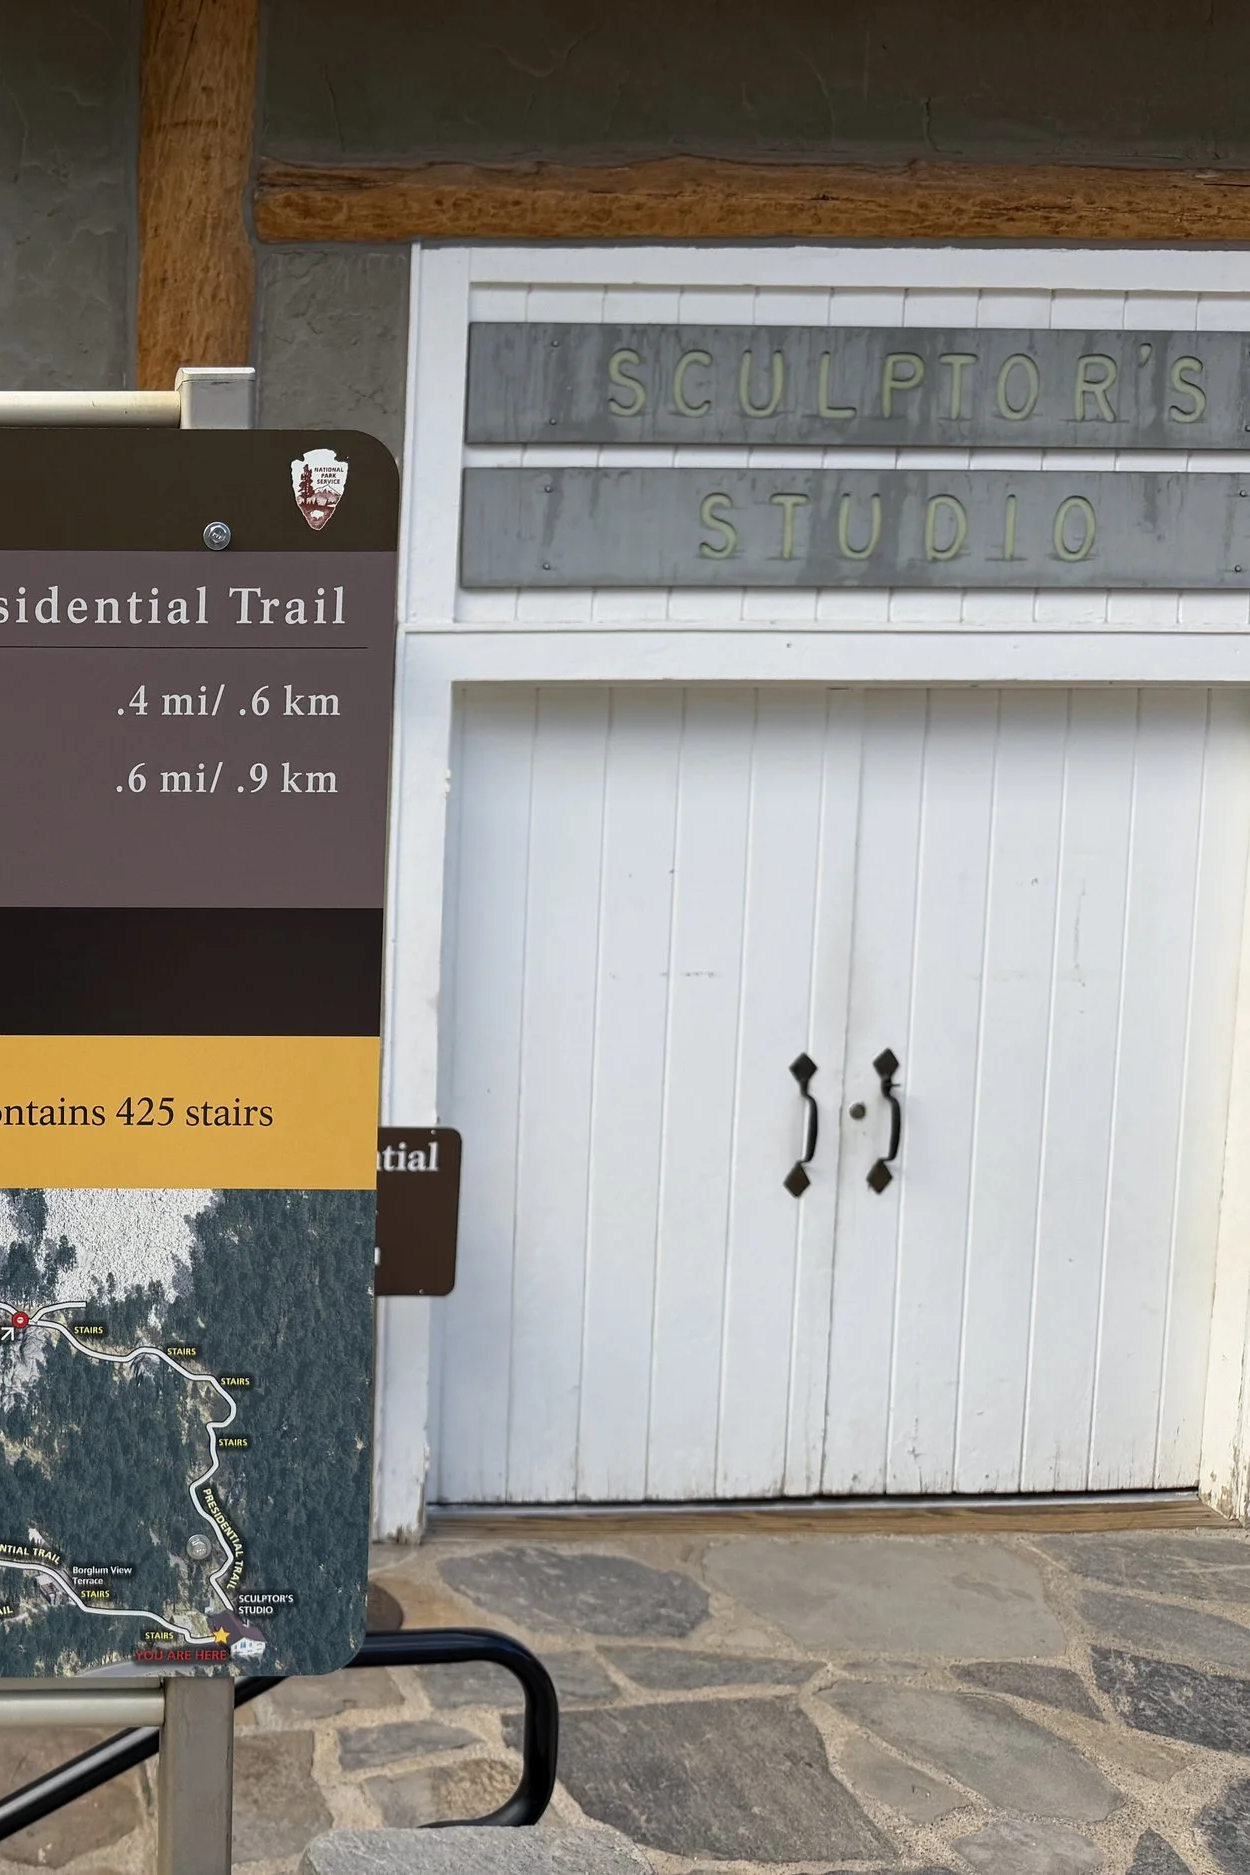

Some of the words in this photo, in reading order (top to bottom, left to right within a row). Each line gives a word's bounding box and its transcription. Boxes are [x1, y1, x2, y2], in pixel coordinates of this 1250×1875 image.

[608, 342, 1207, 425] SCULPTOR'S
[699, 492, 1097, 562] STUDIO
[228, 586, 346, 625] Trail
[117, 685, 148, 716] .4
[161, 684, 225, 716] mi/
[238, 685, 270, 716] .6
[283, 684, 340, 716] km
[116, 762, 147, 793] .6
[160, 761, 223, 793] mi/
[237, 763, 268, 793] .9
[281, 762, 338, 793] km
[115, 1096, 174, 1127] 425
[185, 1097, 274, 1127] stairs
[74, 1326, 103, 1334] STAIRS
[167, 1347, 196, 1356] STAIRS
[220, 1377, 250, 1386] STAIRS
[218, 1438, 248, 1447] STAIRS
[203, 1488, 244, 1558] PRESIDENTIAL
[226, 1560, 244, 1589] TRAIL
[32, 1548, 61, 1564] TRAIL
[72, 1566, 108, 1576] Borglum
[110, 1566, 132, 1574] View
[73, 1577, 104, 1585] Terrace
[81, 1590, 110, 1598] STAIRS
[238, 1594, 294, 1603] SCULPTOR'S
[238, 1606, 274, 1614] STUDIO
[145, 1632, 174, 1640] STAIRS
[134, 1650, 164, 1661] YOU
[167, 1650, 191, 1661] ARE
[195, 1650, 227, 1661] HERE
